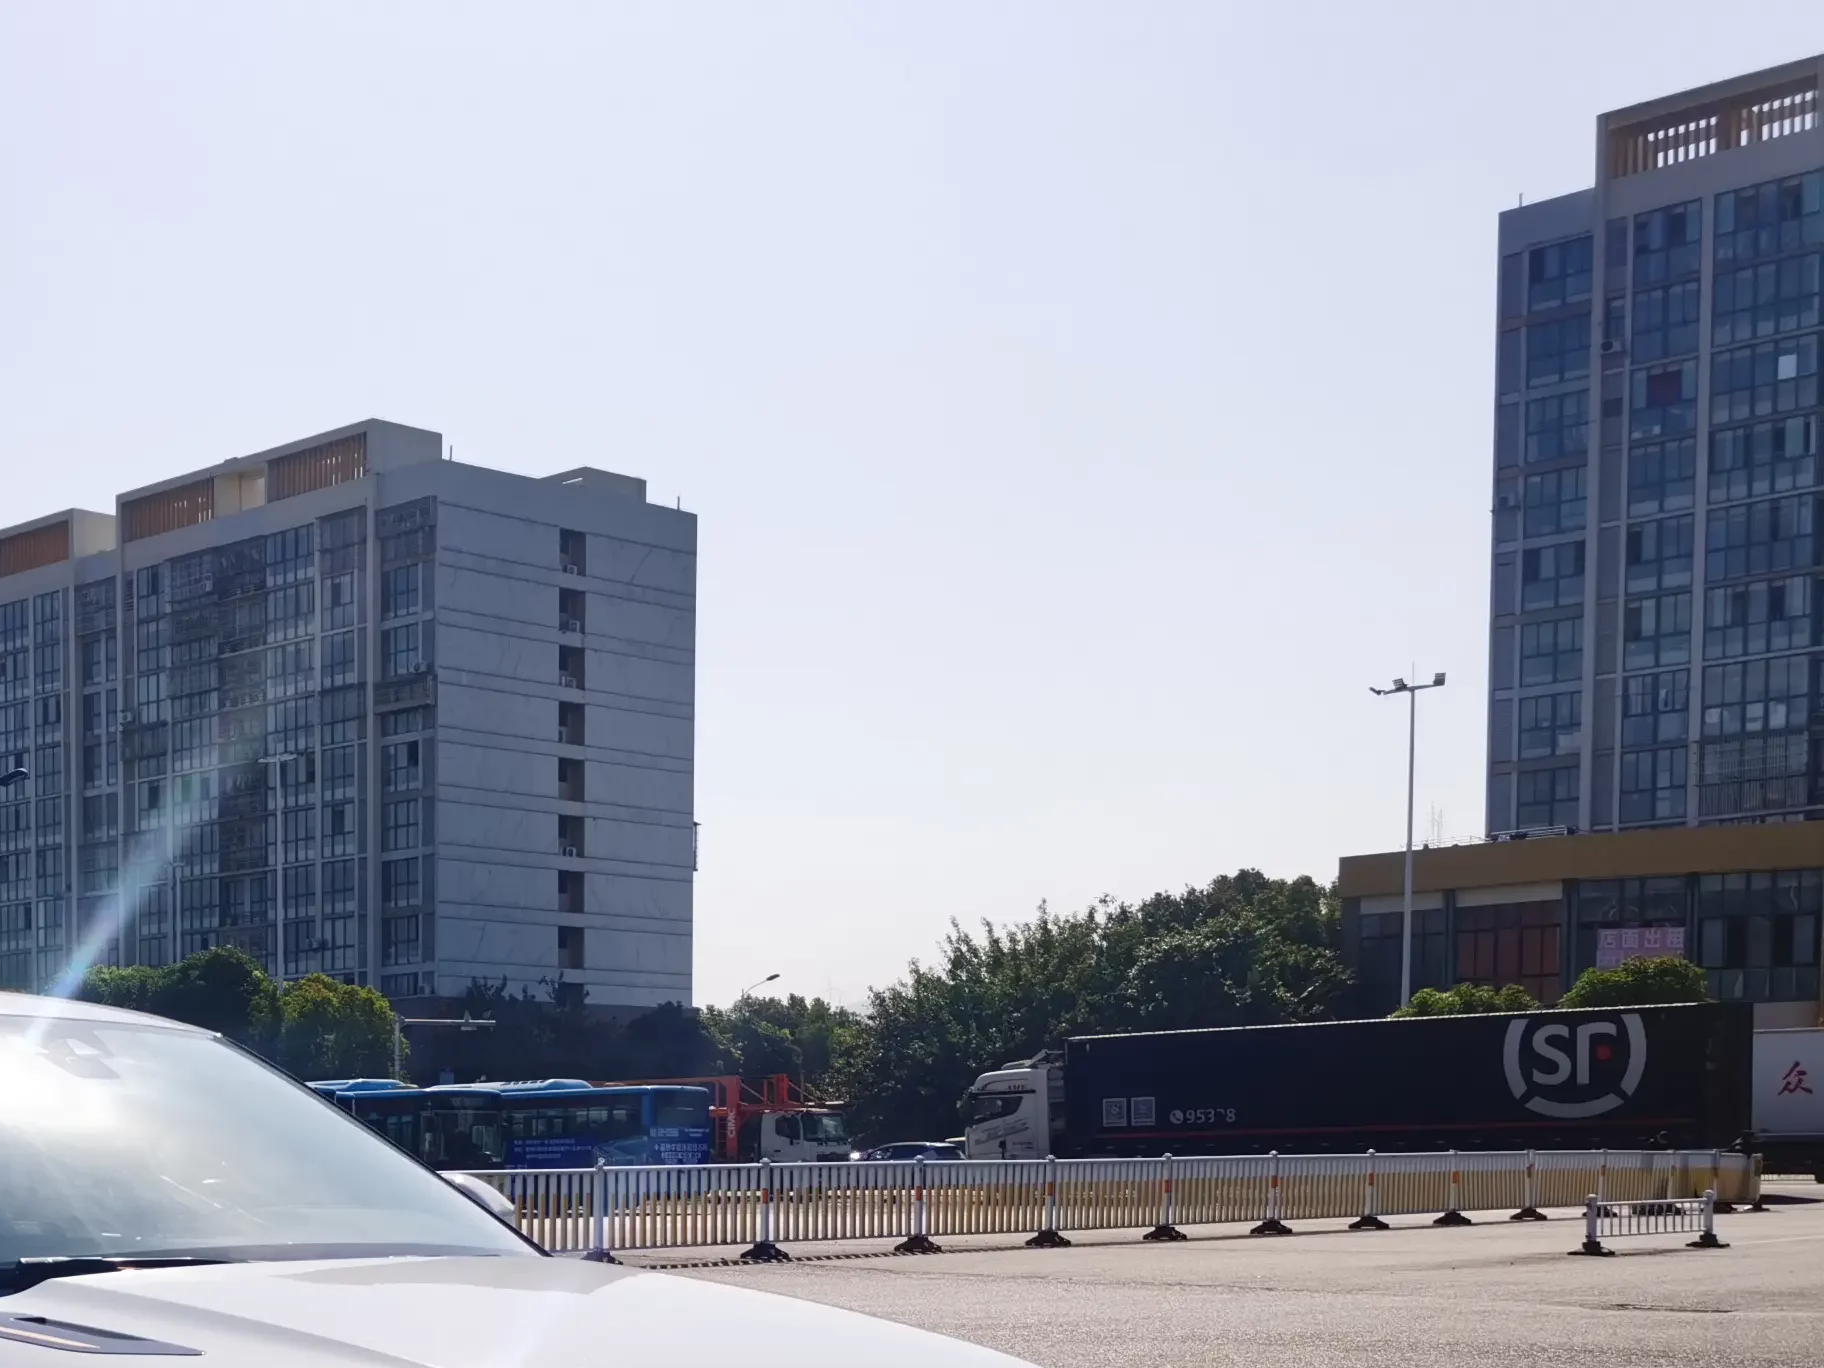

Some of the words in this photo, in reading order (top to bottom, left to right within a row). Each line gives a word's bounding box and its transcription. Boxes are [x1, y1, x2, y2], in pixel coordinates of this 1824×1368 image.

[1598, 927, 1685, 948] 店面出租
[1777, 1060, 1814, 1096] 众
[727, 1107, 736, 1138] CIMC
